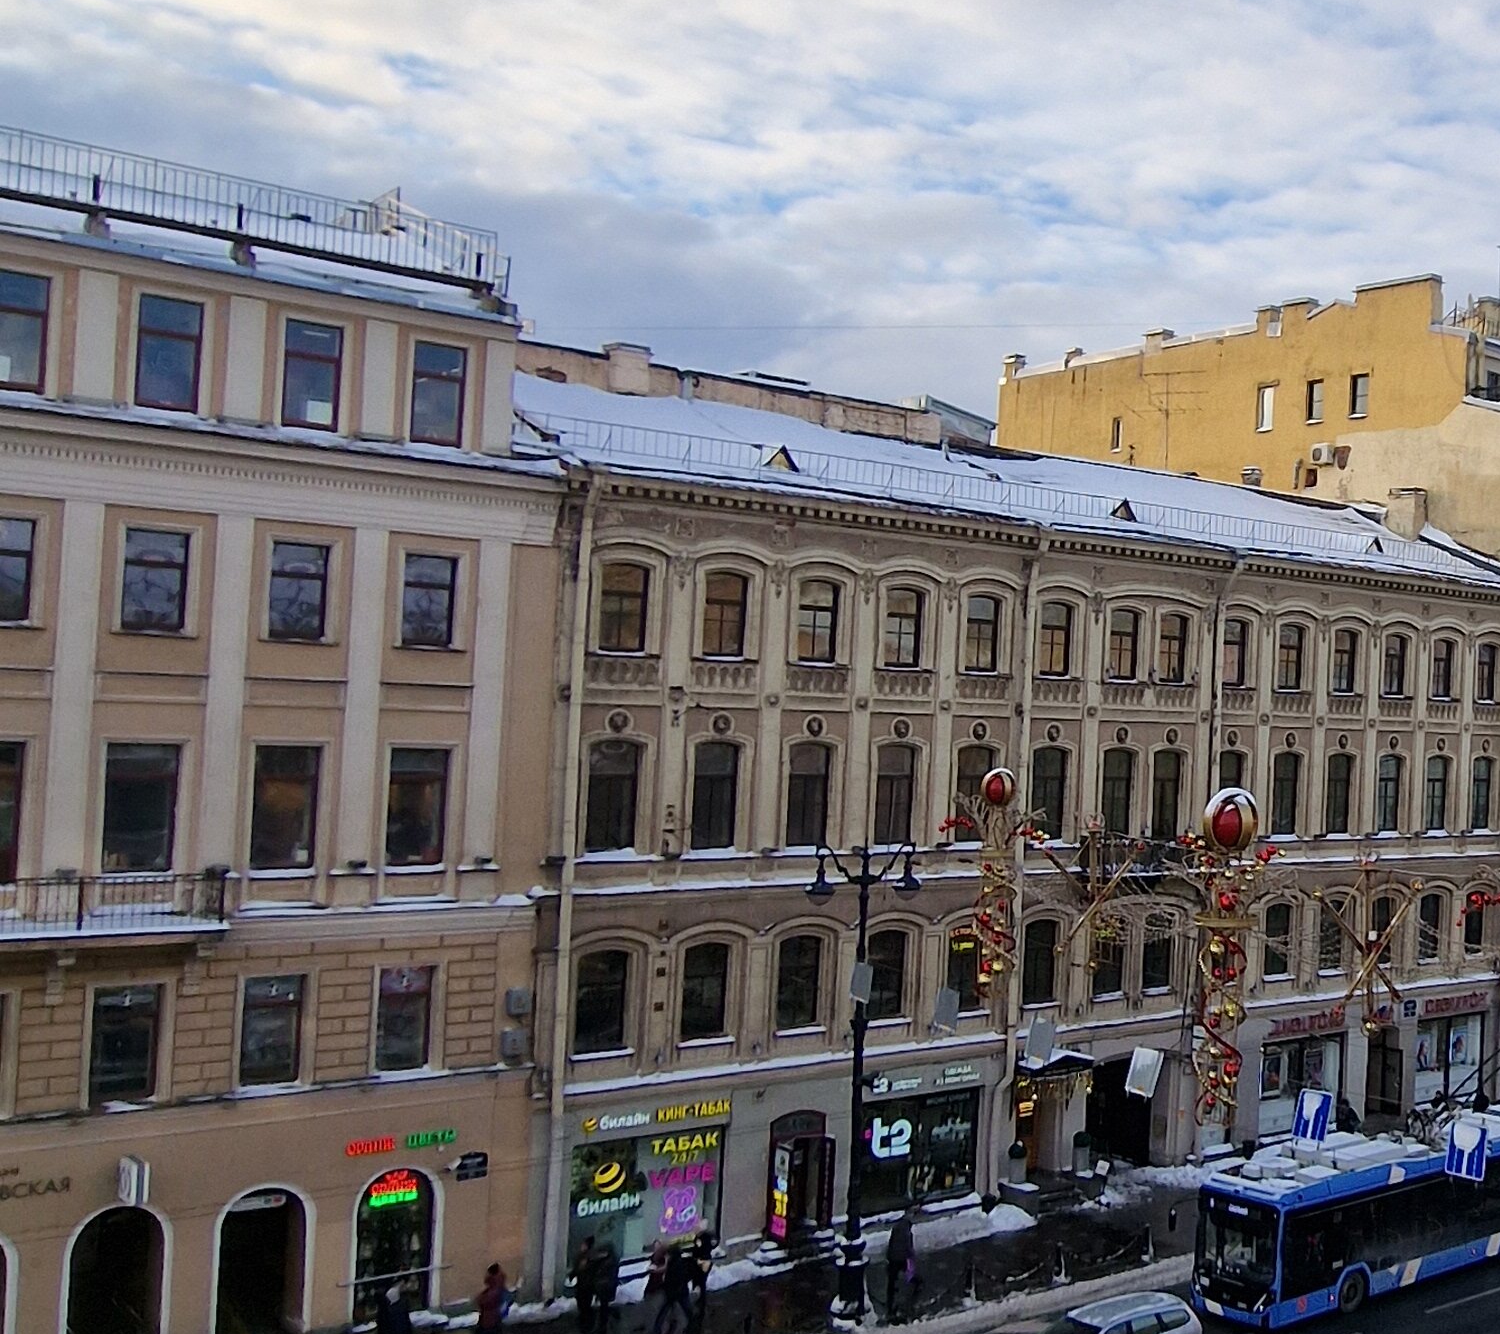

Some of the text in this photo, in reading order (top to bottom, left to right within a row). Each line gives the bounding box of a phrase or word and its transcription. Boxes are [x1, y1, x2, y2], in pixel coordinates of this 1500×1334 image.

[600, 1099, 731, 1130] билайн КИНГ-ТАБАК
[651, 1131, 720, 1155] ТАБАК
[671, 1151, 698, 1166] 24/7
[650, 1162, 717, 1189] VAPE
[577, 1193, 641, 1217] билайн
